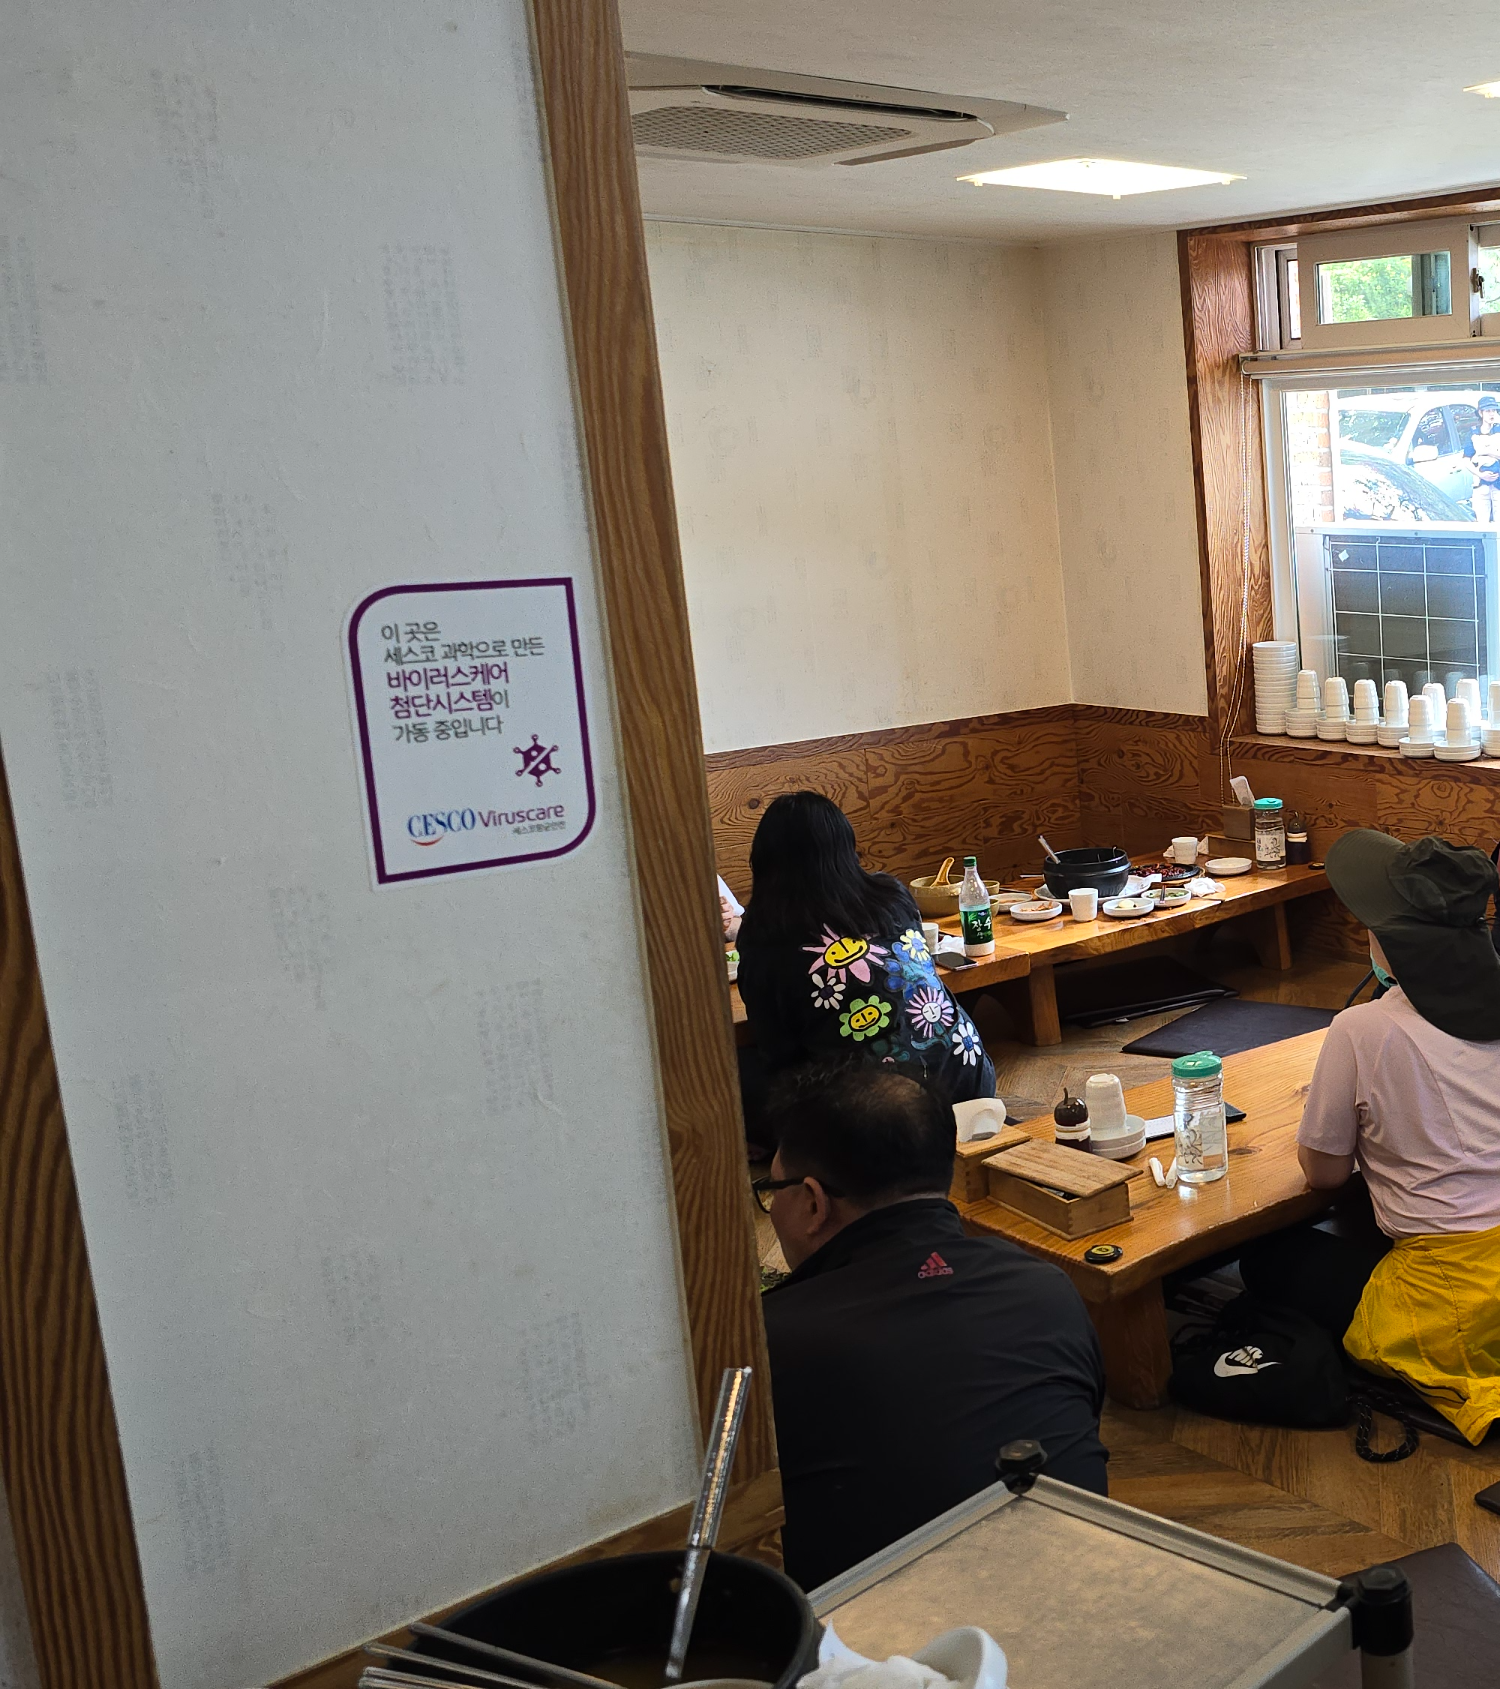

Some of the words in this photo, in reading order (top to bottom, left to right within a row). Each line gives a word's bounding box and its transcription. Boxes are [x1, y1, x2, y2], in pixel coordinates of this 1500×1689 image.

[917, 267, 954, 279] adidas
[381, 623, 400, 643] 이
[404, 621, 442, 643] 곳은
[384, 645, 439, 666] 세스코
[441, 640, 510, 660] 과학으로
[510, 637, 546, 657] 만든
[386, 661, 510, 692] 바이러스케어
[390, 688, 510, 720] 첨단시스템이
[392, 722, 430, 744] 가동
[433, 714, 505, 741] 중입니다
[407, 808, 476, 838] CESCO
[477, 804, 565, 828] Viruscare
[971, 916, 992, 932] 장수
